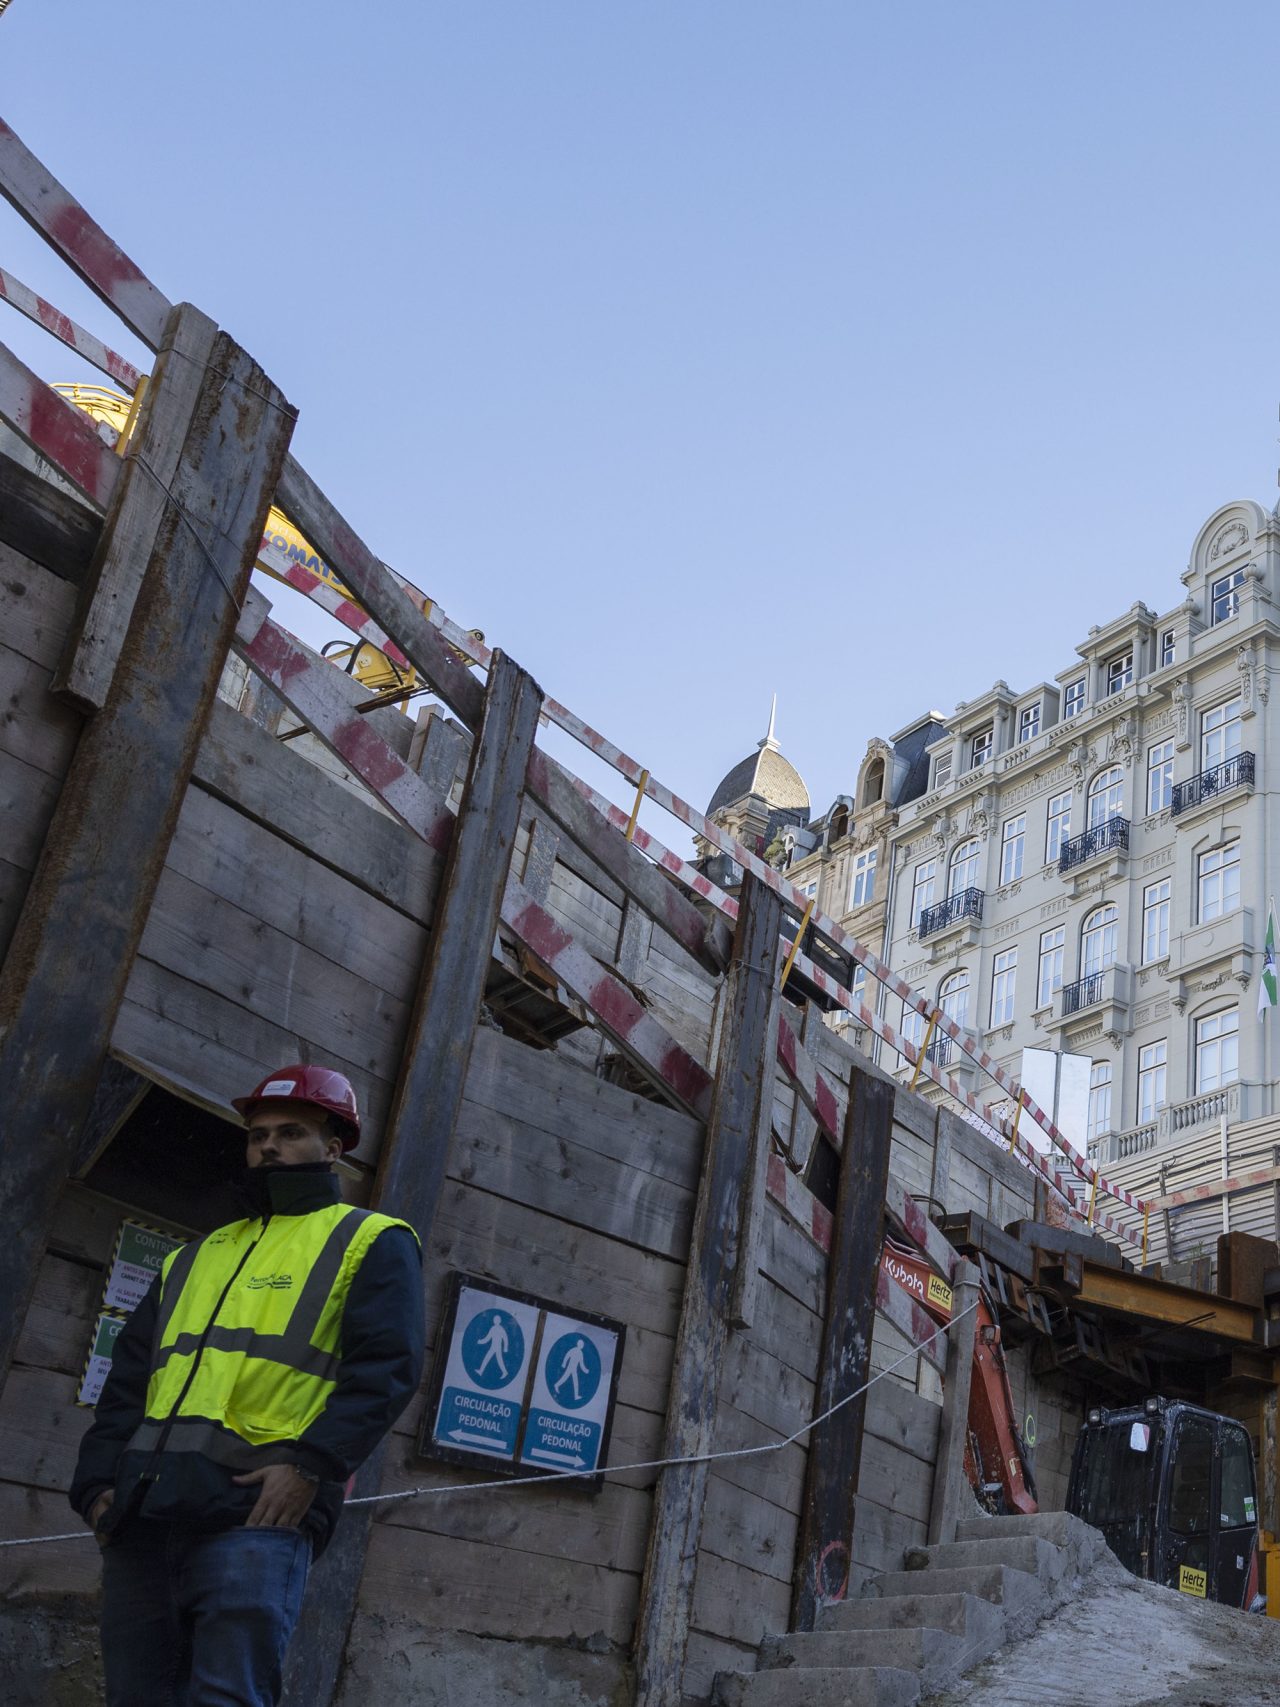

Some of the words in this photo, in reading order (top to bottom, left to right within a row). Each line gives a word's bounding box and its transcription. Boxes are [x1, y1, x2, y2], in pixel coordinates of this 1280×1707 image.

[135, 1233, 174, 1253] CONTRO
[143, 1254, 162, 1267] ACC
[885, 1256, 924, 1295] Kubota
[931, 1279, 951, 1299] Hertz
[454, 1395, 511, 1418] CIRCULAÇÃO
[458, 1413, 501, 1433] PEDONAL
[537, 1415, 592, 1437] CIRCULAÇÃO
[541, 1433, 582, 1452] PEDONAL
[1182, 1570, 1204, 1588] Hertz
